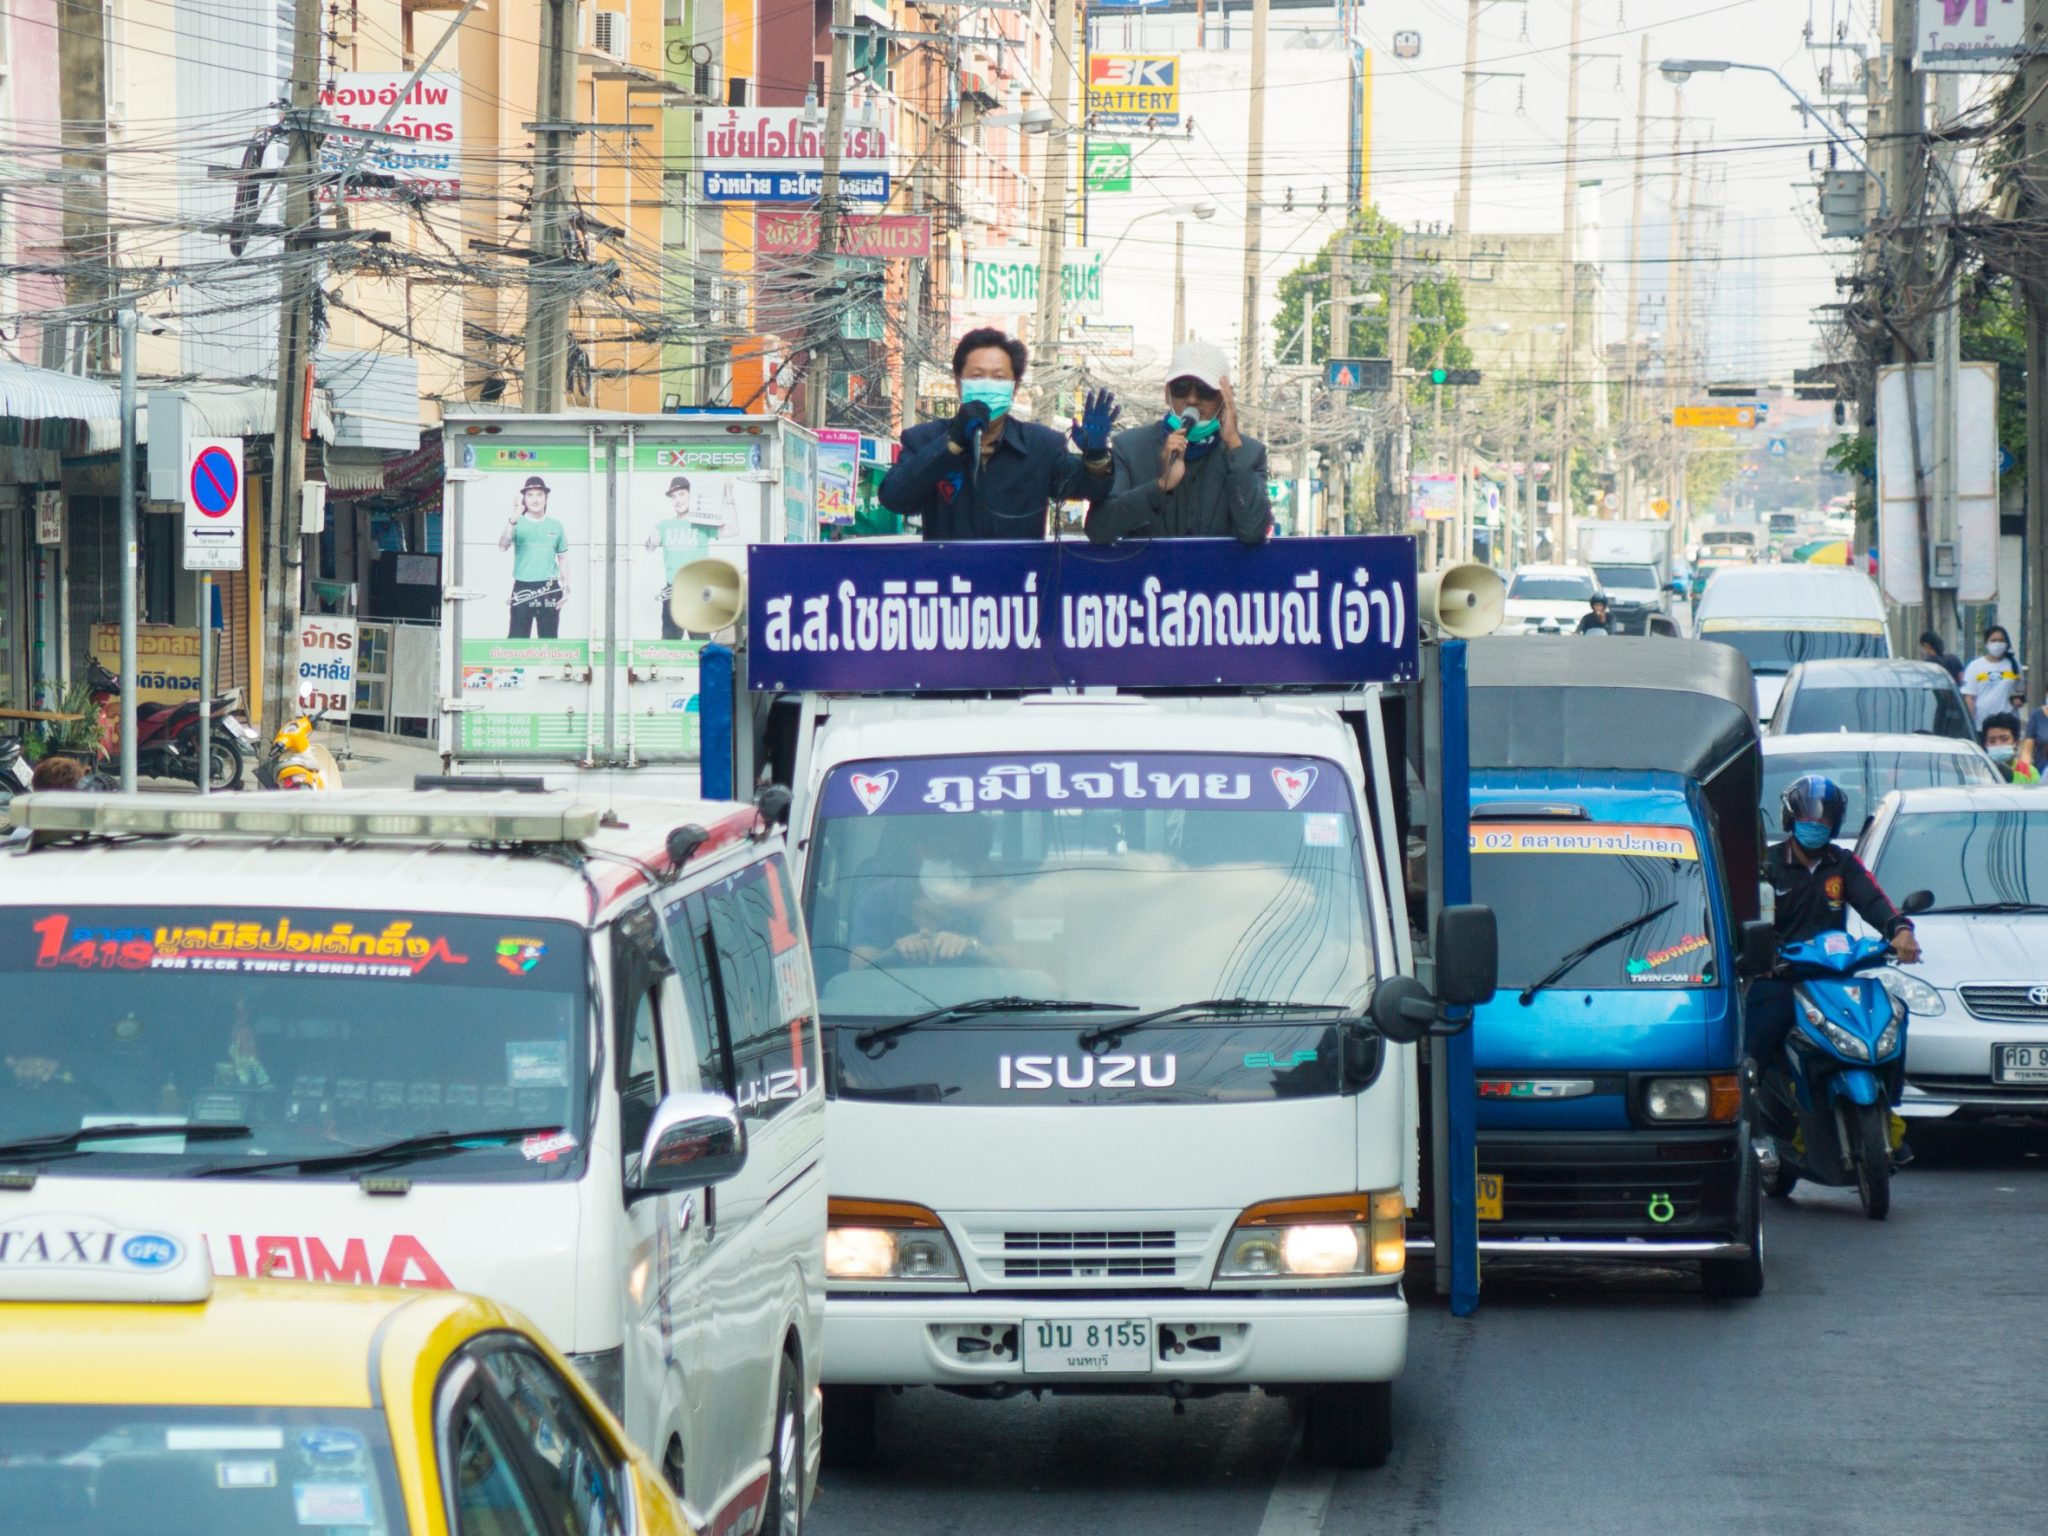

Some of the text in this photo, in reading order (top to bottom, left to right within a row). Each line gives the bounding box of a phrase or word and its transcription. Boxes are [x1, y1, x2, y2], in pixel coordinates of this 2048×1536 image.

[1090, 91, 1174, 110] BATTERY
[708, 173, 772, 195] จำหน่าย
[657, 449, 746, 467] EXPRESS
[765, 572, 1041, 651] ส.ส.โชติพิพัฒน์
[302, 624, 352, 651] จักร
[922, 761, 1251, 813] ภูมิใจไทย
[1486, 833, 1683, 854] 02 ตลาดบางปะกอก
[191, 959, 239, 970] TECK
[294, 961, 412, 977] FOUNDATION
[999, 1055, 1176, 1089] ISUZU
[1479, 1081, 1576, 1097] HIJET
[0, 1231, 170, 1264] TAXI GPS
[1086, 1324, 1147, 1347] 8155
[1067, 1353, 1109, 1370] นนทบุรี
